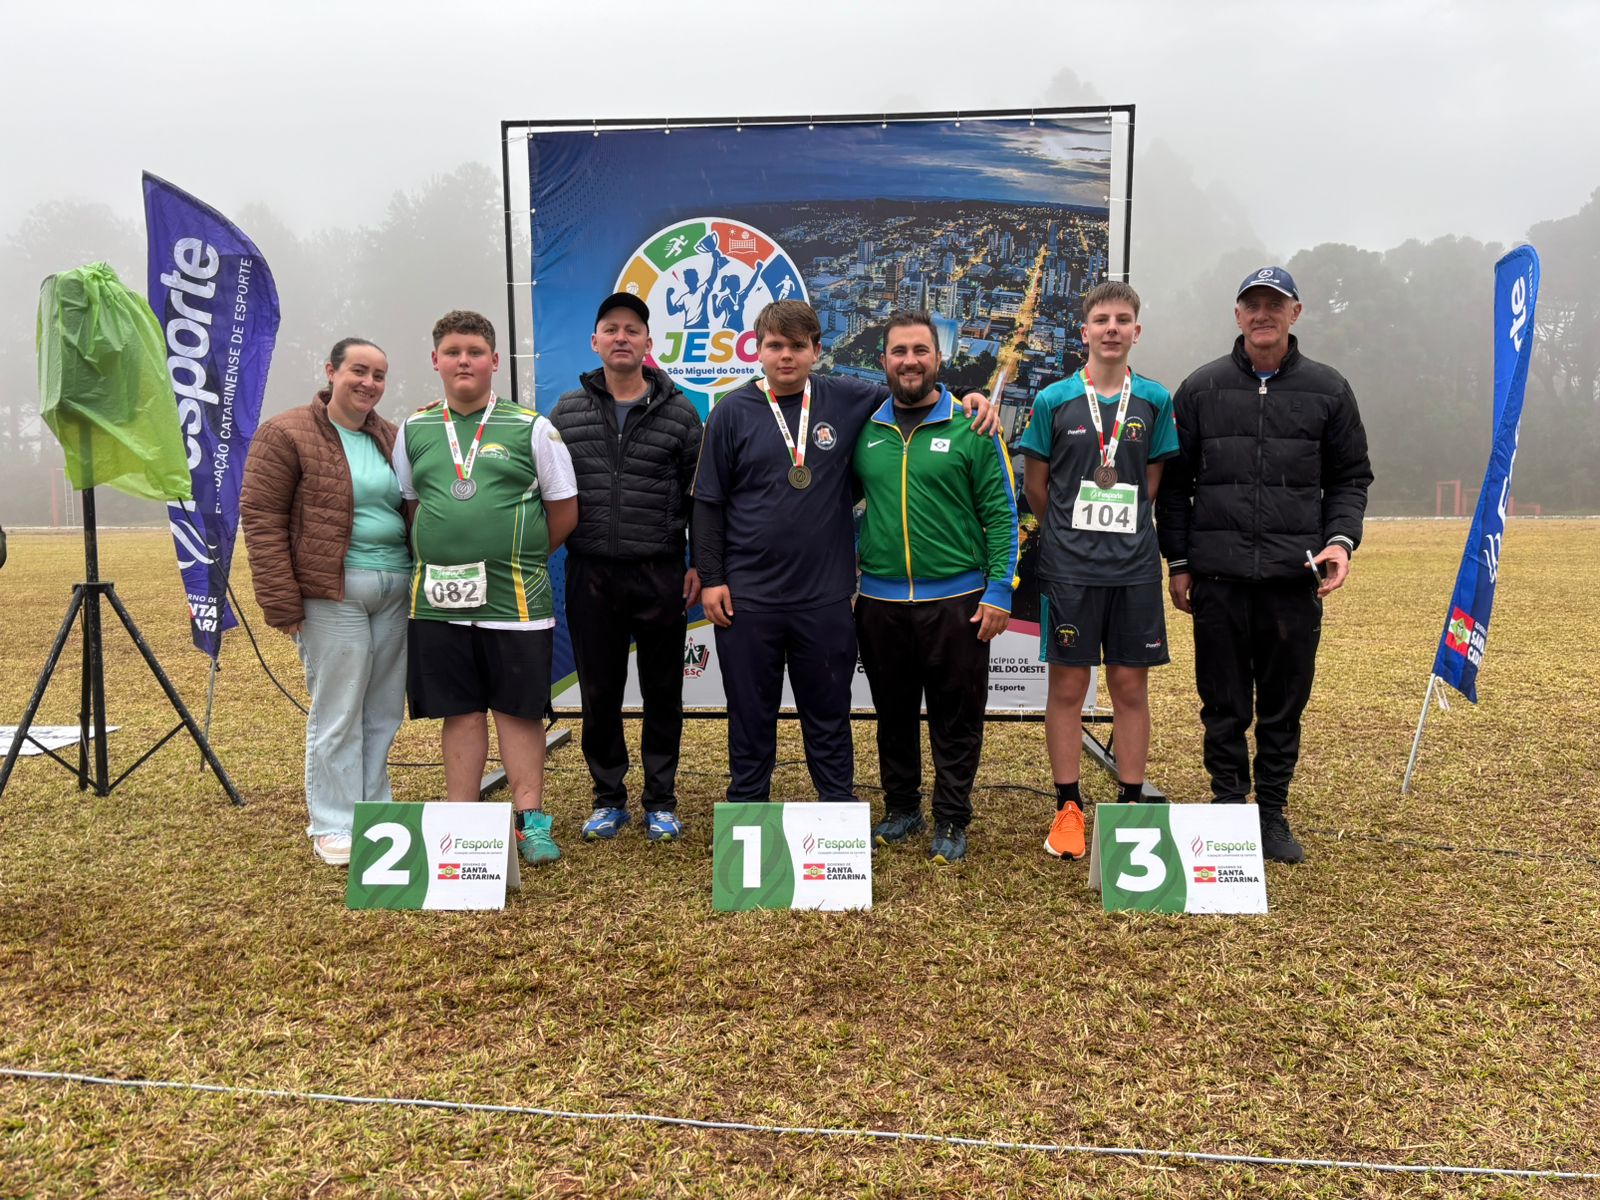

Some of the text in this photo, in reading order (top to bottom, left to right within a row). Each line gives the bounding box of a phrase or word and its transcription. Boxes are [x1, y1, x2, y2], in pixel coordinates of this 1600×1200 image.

[234, 257, 253, 321] ESPORTE
[231, 325, 245, 345] DE
[667, 366, 755, 377] São Miguel do Oeste
[220, 346, 241, 439] CATARINENSE
[1082, 504, 1130, 528] 104
[432, 581, 479, 603] 082
[684, 668, 703, 678] ESC
[989, 665, 1004, 673] UEL
[1005, 665, 1019, 673] DO
[995, 684, 1025, 692] Esporte
[361, 822, 412, 885] 2
[454, 838, 504, 851] Fesporte
[817, 838, 867, 851] Fesporte
[1206, 840, 1257, 853] Fesporte
[732, 825, 762, 888] 1
[1115, 827, 1167, 892] 3
